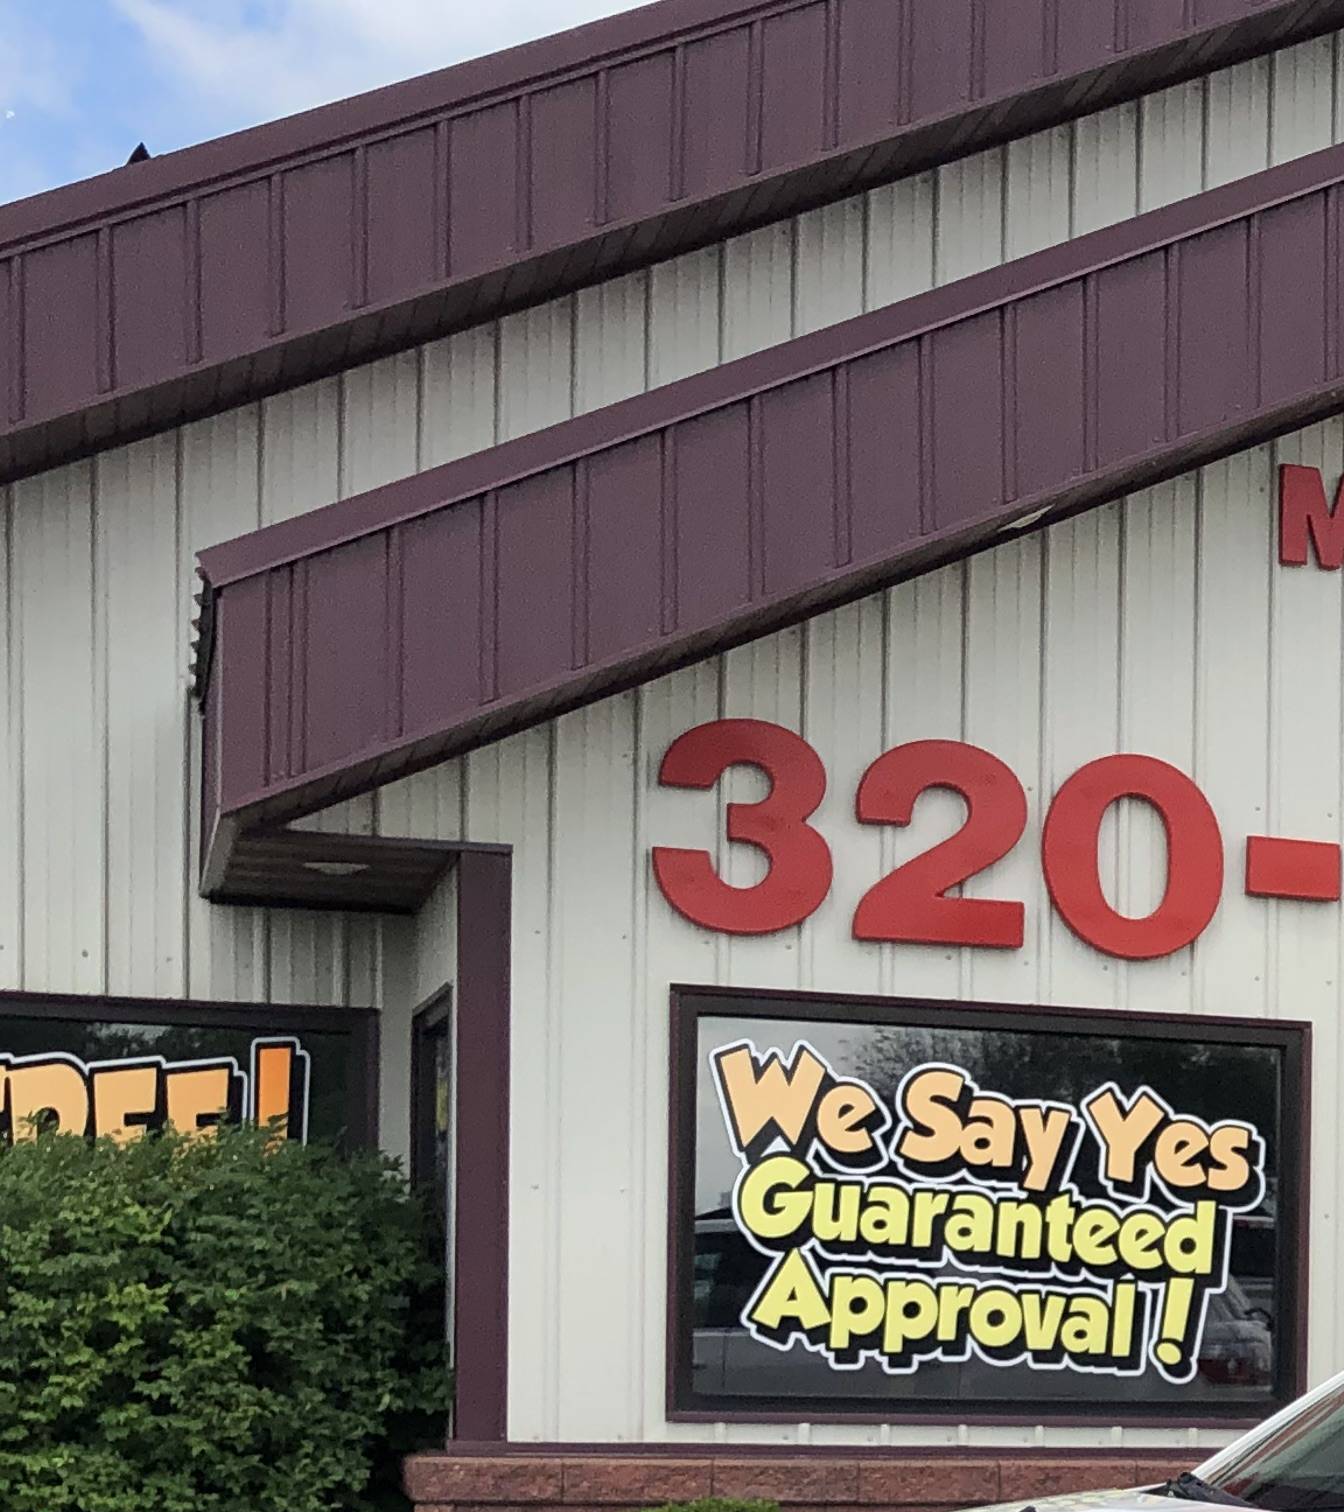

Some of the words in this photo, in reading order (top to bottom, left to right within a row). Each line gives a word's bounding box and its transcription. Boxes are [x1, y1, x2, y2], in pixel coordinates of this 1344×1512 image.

[716, 1045, 876, 1154] We
[899, 1067, 1072, 1192] Say
[1087, 1088, 1251, 1191] Yes
[739, 1156, 1218, 1276] Guaranteed
